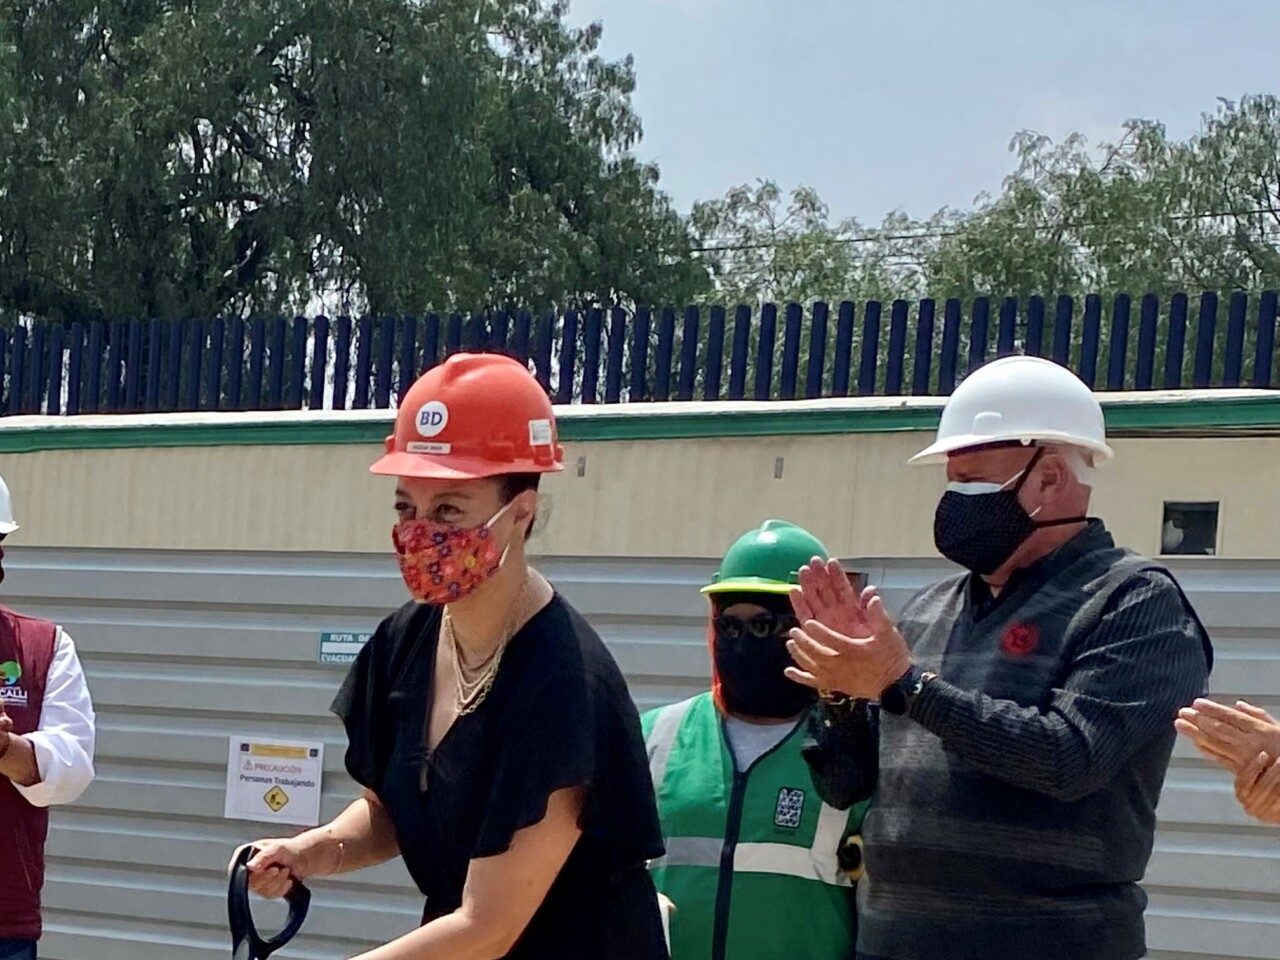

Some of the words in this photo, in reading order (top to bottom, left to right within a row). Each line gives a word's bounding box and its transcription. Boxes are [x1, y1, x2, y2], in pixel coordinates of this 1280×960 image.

[420, 411, 443, 426] BD
[330, 633, 354, 642] RUTA
[240, 774, 273, 784] Personas
[274, 777, 316, 788] Trabajando
